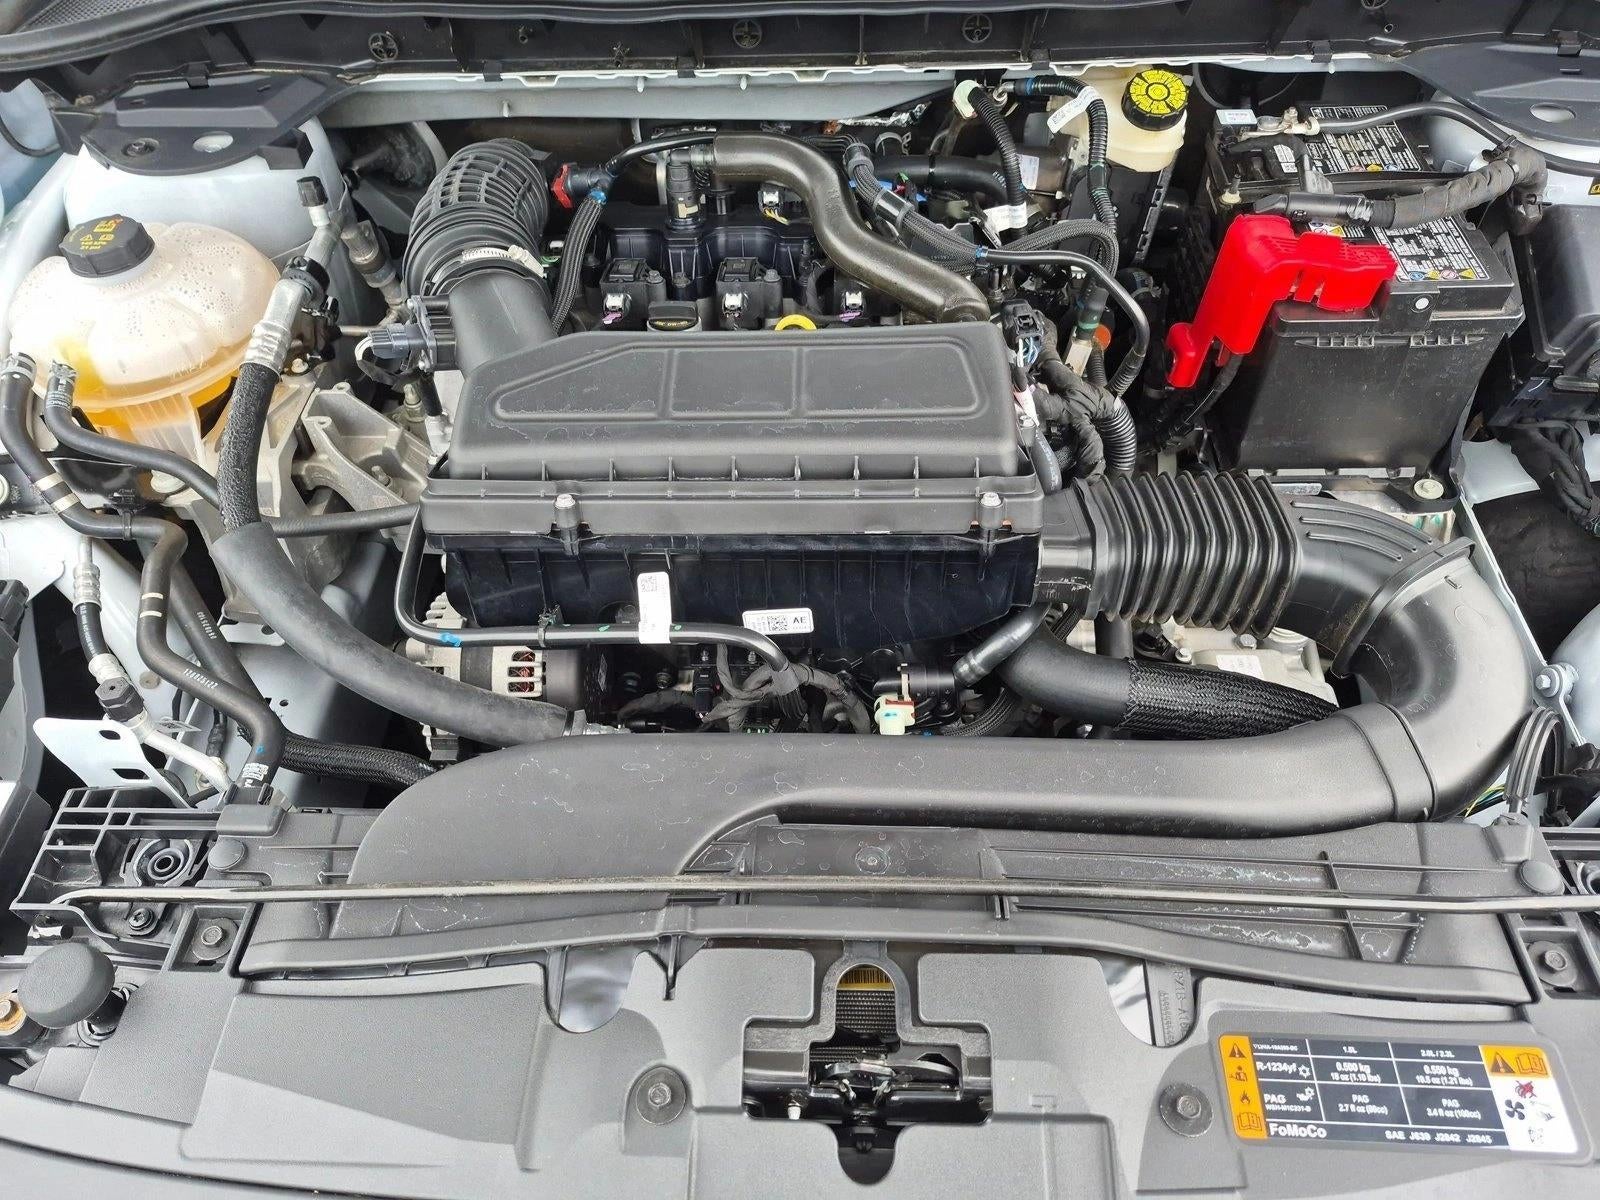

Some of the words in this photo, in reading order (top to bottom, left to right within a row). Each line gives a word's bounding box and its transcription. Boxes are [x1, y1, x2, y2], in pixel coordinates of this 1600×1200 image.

[1256, 1062, 1298, 1074] R-1234yf
[1358, 1062, 1371, 1074] kg
[1446, 1066, 1460, 1078] kg
[1264, 1093, 1287, 1104] PAG
[1352, 1094, 1369, 1104] PAG
[1442, 1098, 1460, 1108] PAG
[1338, 1103, 1350, 1112] 2.7
[1268, 1123, 1327, 1138] FoMoCo
[1385, 1130, 1406, 1140] SAE
